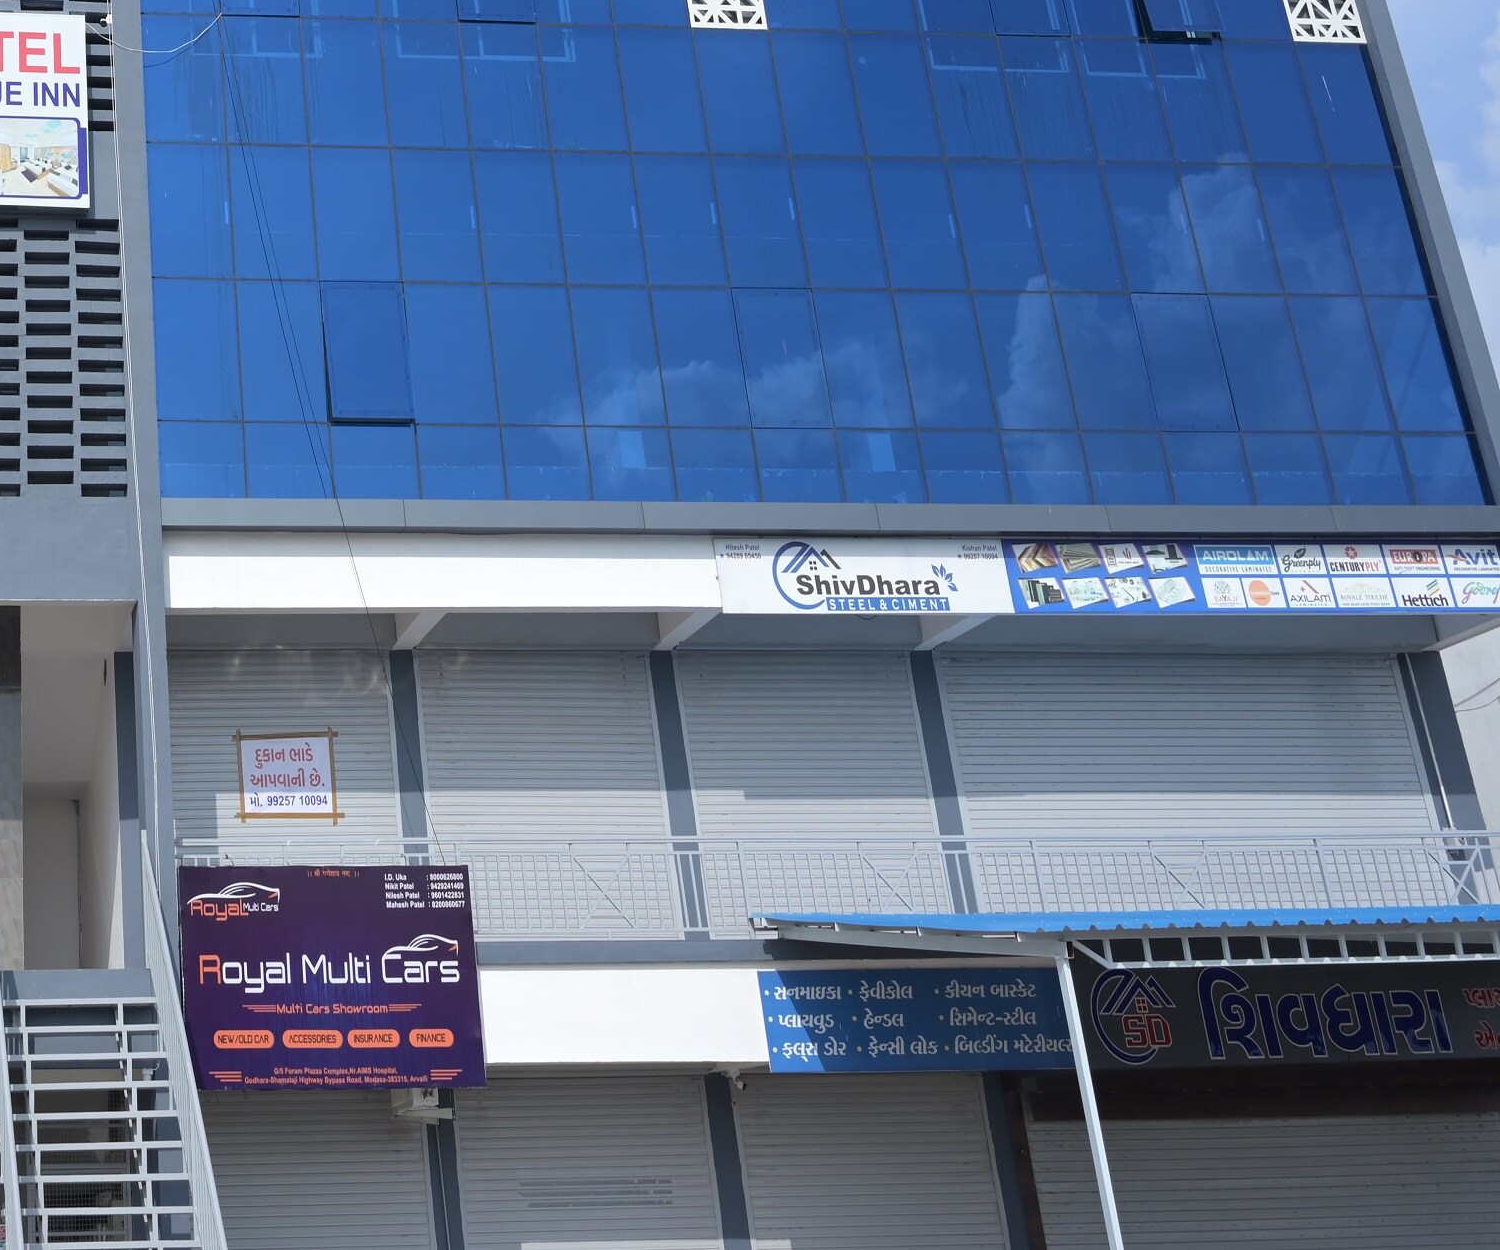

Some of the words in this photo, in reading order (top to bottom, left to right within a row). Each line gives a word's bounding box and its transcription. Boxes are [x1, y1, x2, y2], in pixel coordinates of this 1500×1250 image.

[33, 82, 80, 107] INN
[1203, 550, 1269, 561] AIROLAM
[1281, 554, 1320, 572] Greenply
[1329, 561, 1380, 572] CENTURYPLY
[796, 574, 941, 596] ShivDhara
[829, 599, 876, 611] STEEL
[879, 599, 888, 611] &
[891, 599, 948, 611] CIMENT
[1401, 594, 1449, 607] Hettich
[255, 748, 286, 769] દુકાન
[289, 742, 314, 762] ભાડે
[250, 768, 305, 788] આપવાની
[309, 768, 325, 787] છે.
[250, 792, 263, 807] મો.
[267, 795, 295, 806] 99257
[299, 795, 328, 806] 10094
[260, 903, 279, 911] Cars
[199, 952, 291, 993] Royal
[301, 952, 371, 984] Multi
[381, 953, 460, 983] Cars
[276, 1003, 303, 1014] Multi
[305, 1003, 330, 1014] Cars
[333, 1003, 389, 1014] Showroom
[1197, 966, 1453, 1060] શિવધારા
[353, 1033, 393, 1043] INSURANCE
[416, 1033, 446, 1043] FINANCE
[1122, 1014, 1172, 1048] SD
[254, 1034, 270, 1043] CAR
[288, 1034, 337, 1044] ACCESSORIES
[823, 1036, 847, 1056] ડોર
[910, 1035, 938, 1055] લોક
